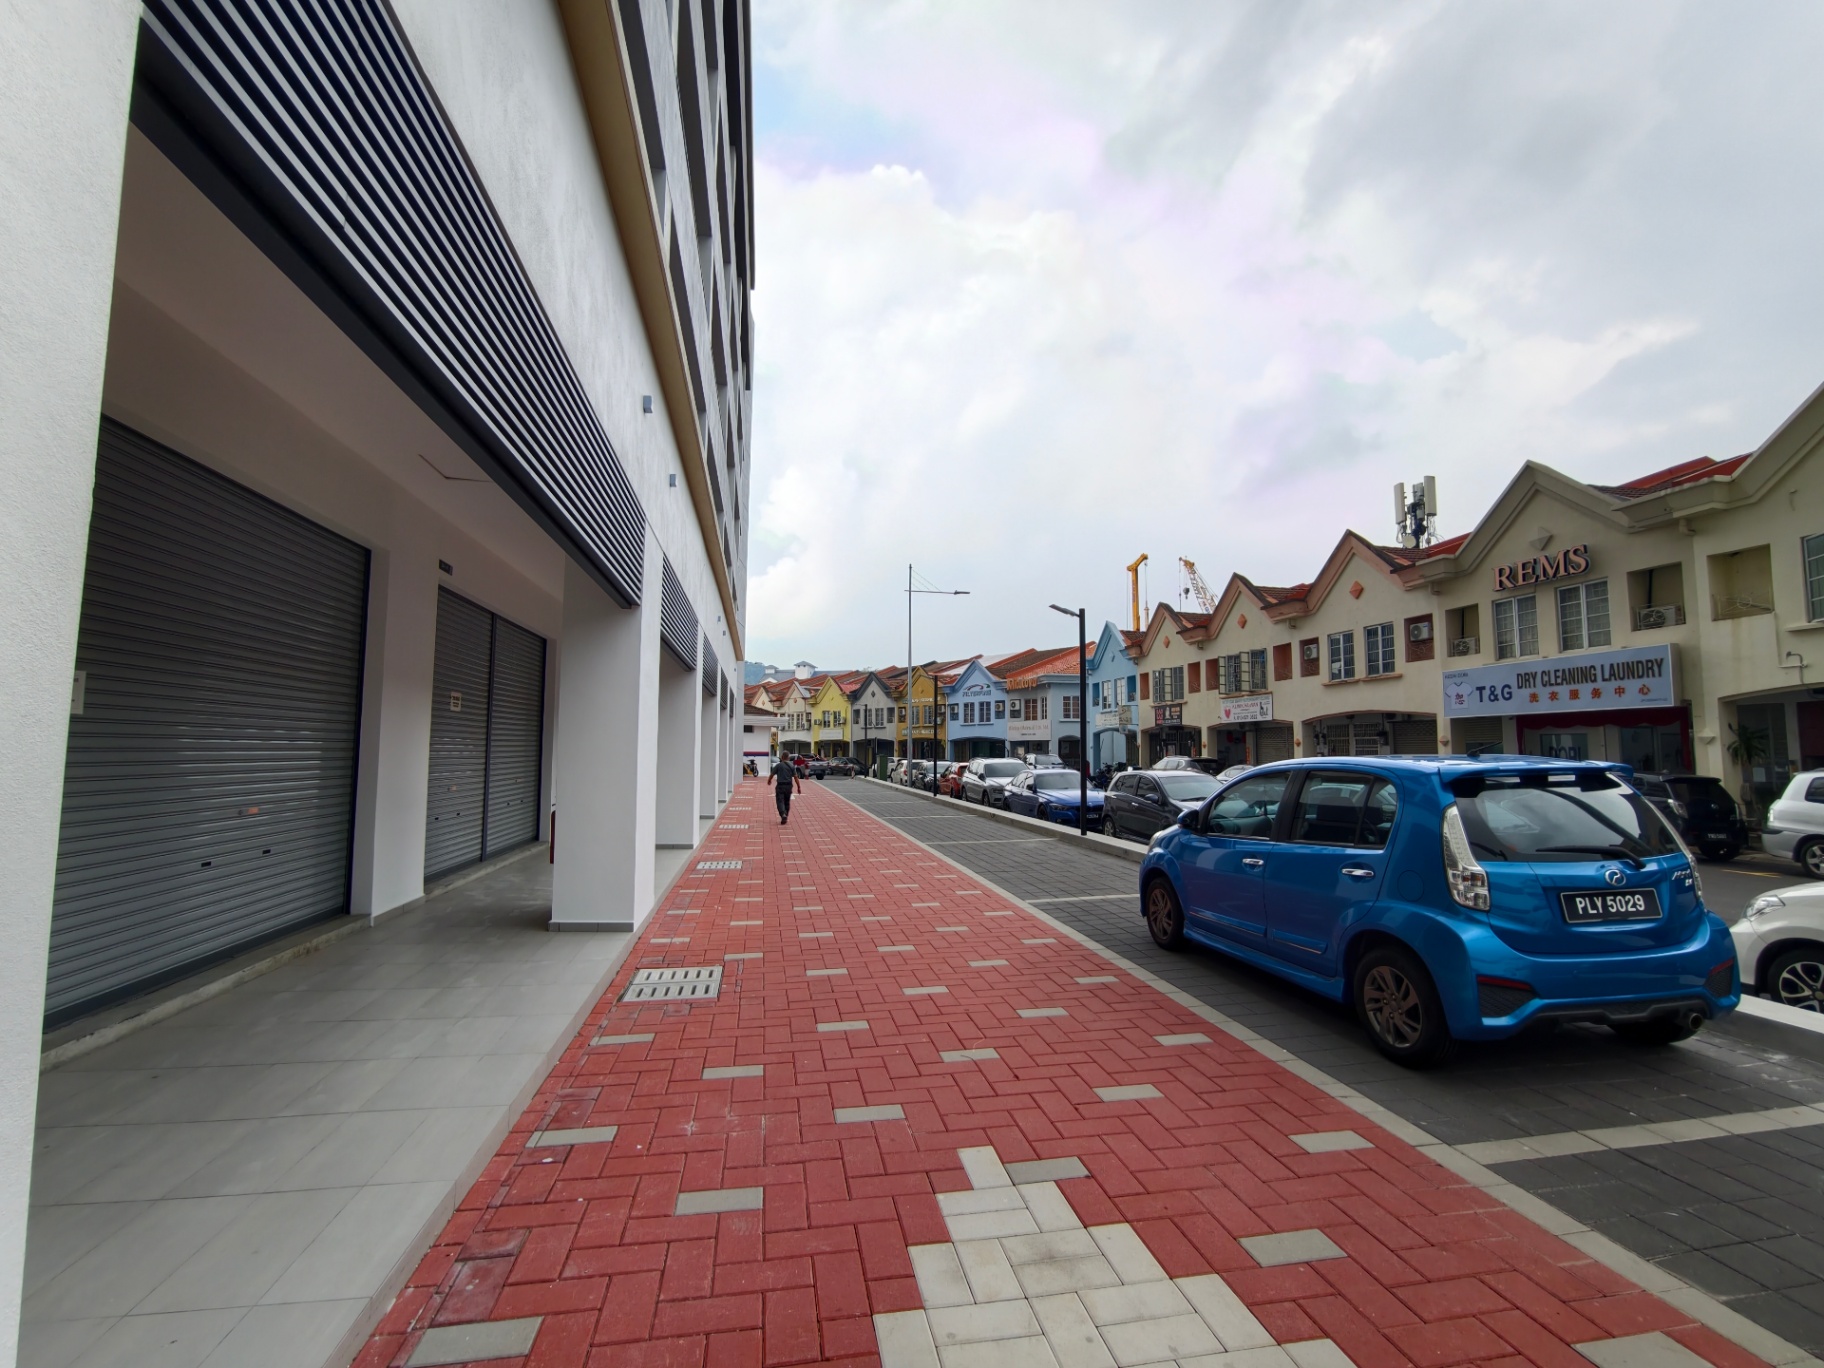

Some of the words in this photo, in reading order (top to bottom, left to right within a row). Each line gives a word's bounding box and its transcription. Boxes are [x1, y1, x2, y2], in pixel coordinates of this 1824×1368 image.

[1492, 544, 1590, 592] REMS
[1516, 671, 1537, 690] DRY
[1540, 664, 1597, 687] CLEANING
[1600, 657, 1665, 683] LAUNDRY
[1476, 684, 1513, 703] T&G
[1529, 683, 1652, 704] 洗衣服务中心
[1575, 896, 1603, 915] PLY
[1607, 894, 1645, 913] 5029
